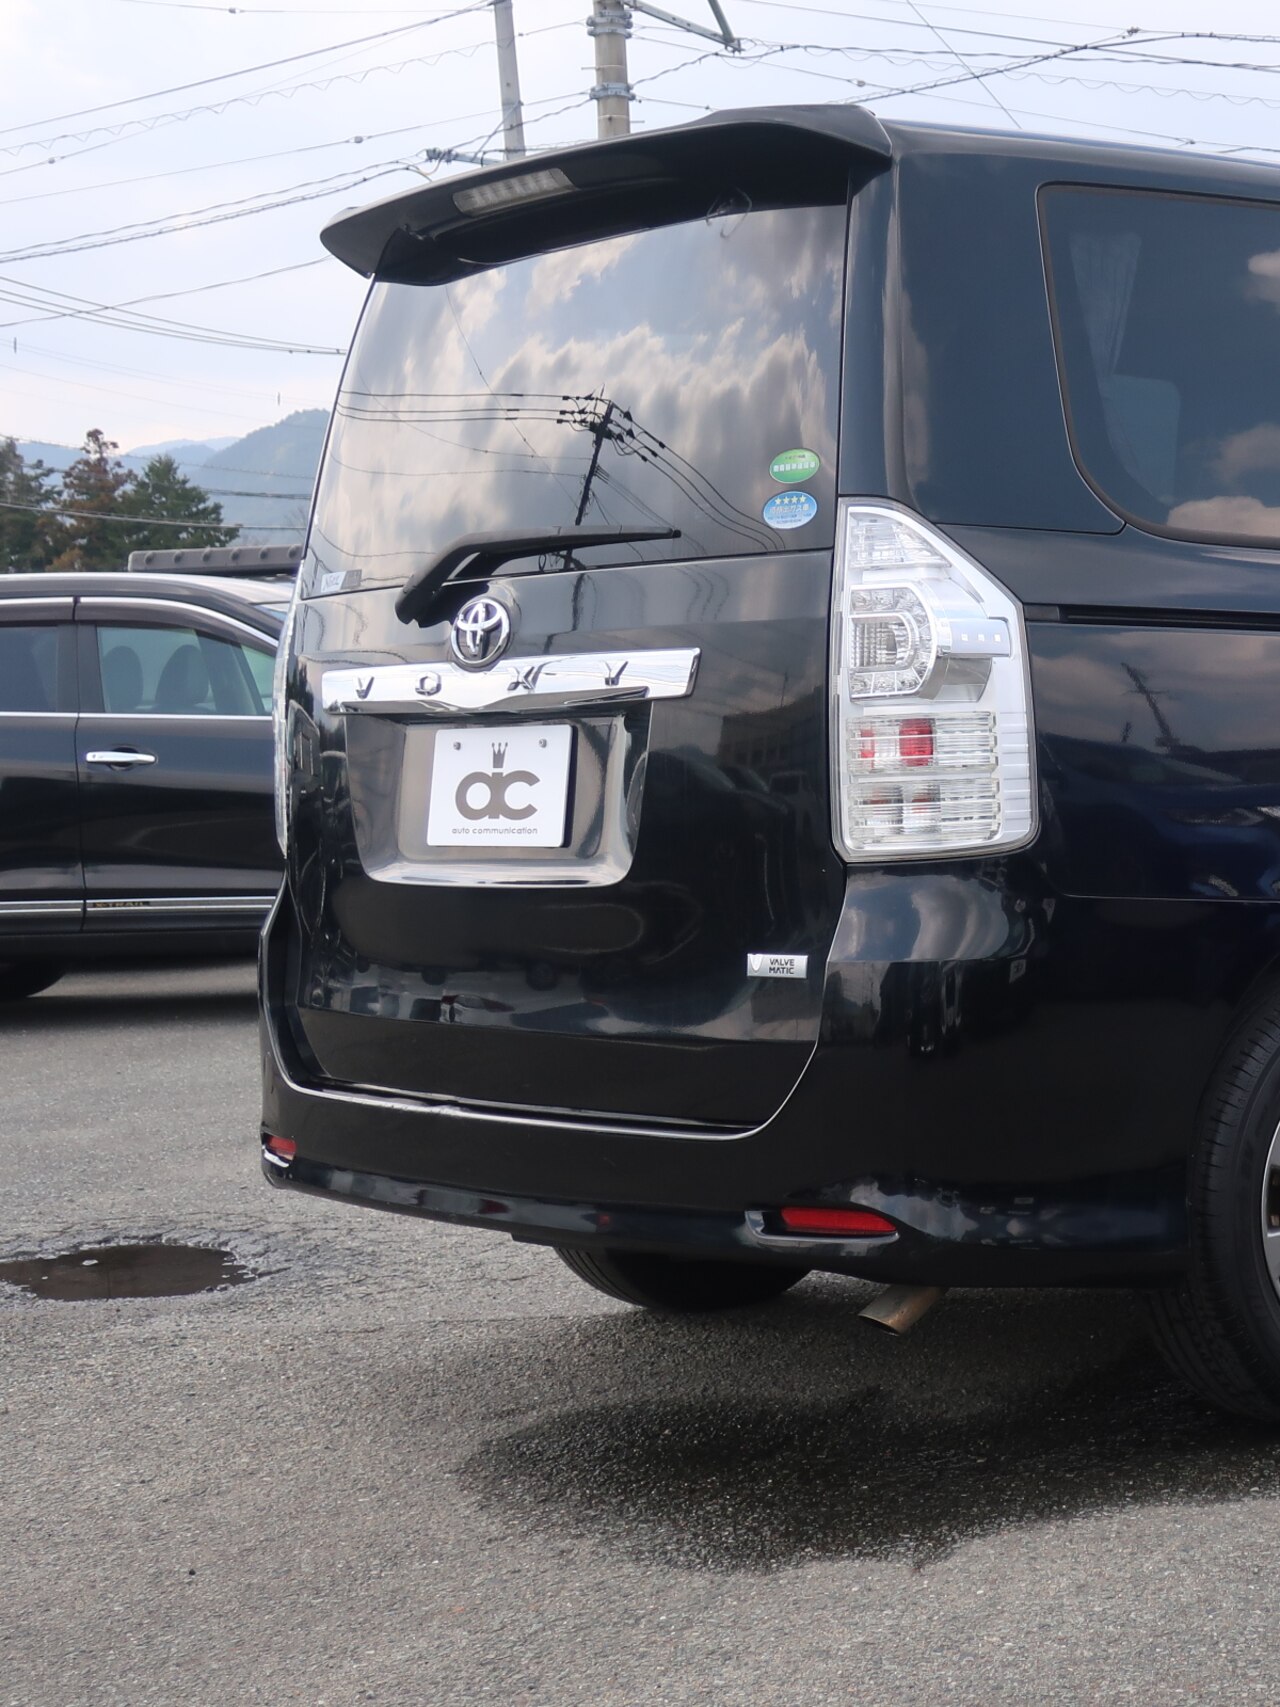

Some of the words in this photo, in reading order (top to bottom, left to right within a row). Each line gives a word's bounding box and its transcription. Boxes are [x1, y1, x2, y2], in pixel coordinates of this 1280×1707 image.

[355, 660, 629, 699] VOXY
[455, 769, 541, 821] ac
[452, 827, 470, 835] auto
[472, 826, 538, 835] communication
[769, 958, 795, 967] VALVE
[768, 966, 795, 975] MATIC
